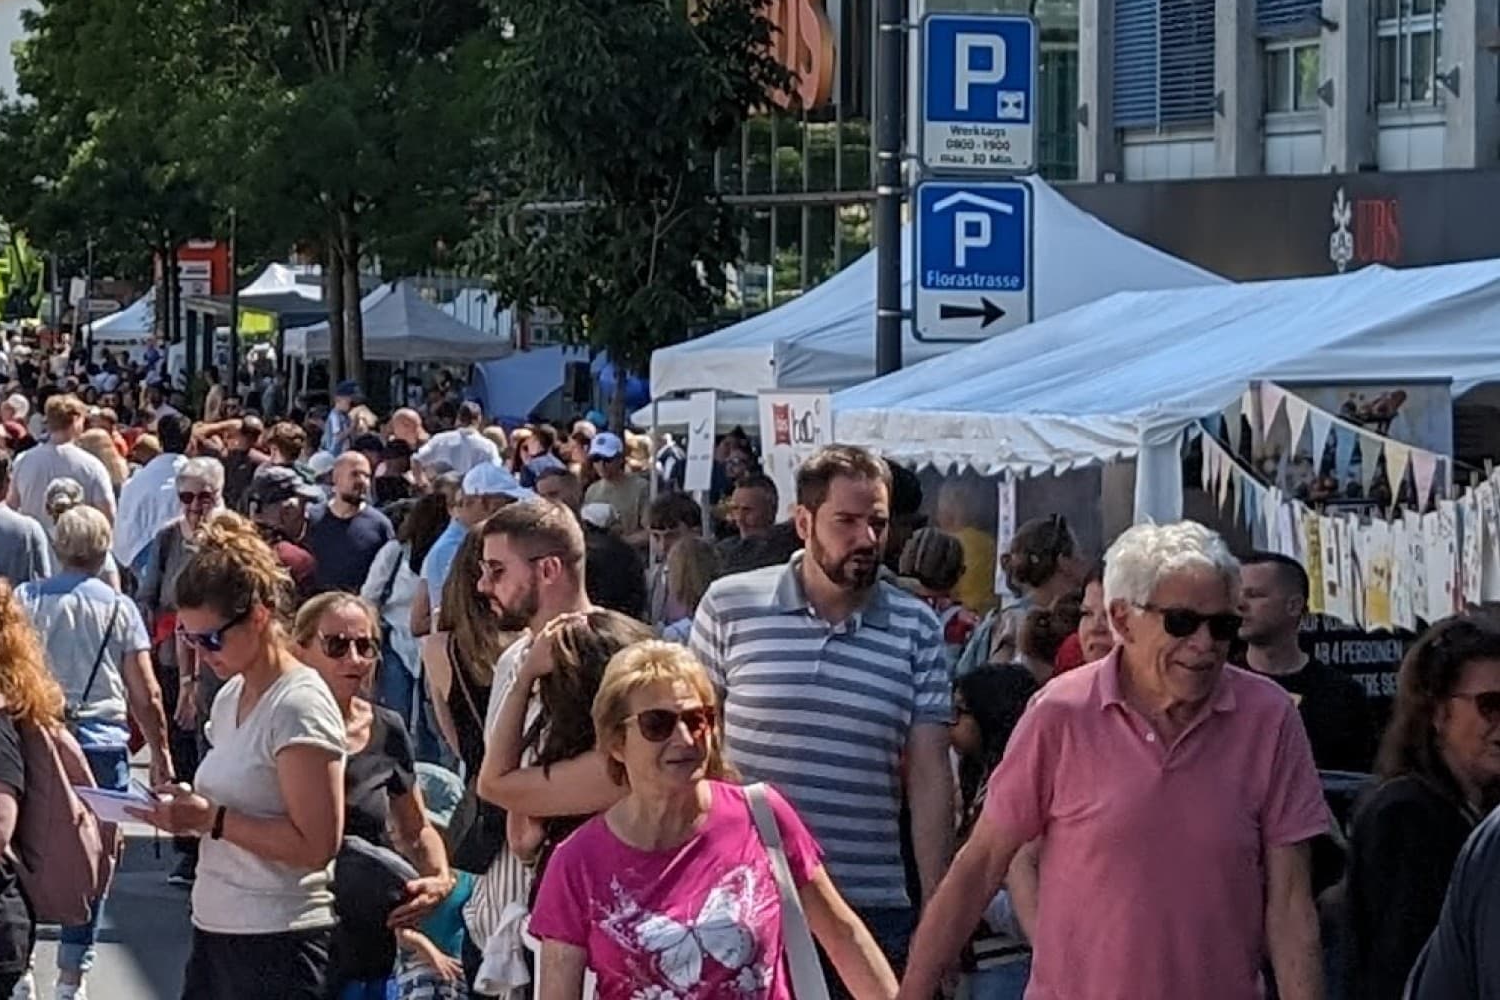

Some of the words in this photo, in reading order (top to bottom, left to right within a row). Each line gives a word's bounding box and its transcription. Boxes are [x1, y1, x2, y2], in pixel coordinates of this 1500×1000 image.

[954, 32, 1006, 111] P
[949, 124, 1007, 138] Werktags
[939, 153, 966, 164] max.
[971, 152, 987, 165] 30
[954, 210, 992, 268] P
[1356, 198, 1401, 262] UBS
[925, 269, 1021, 289] Florastrasse
[1341, 639, 1403, 664] PERSONEN
